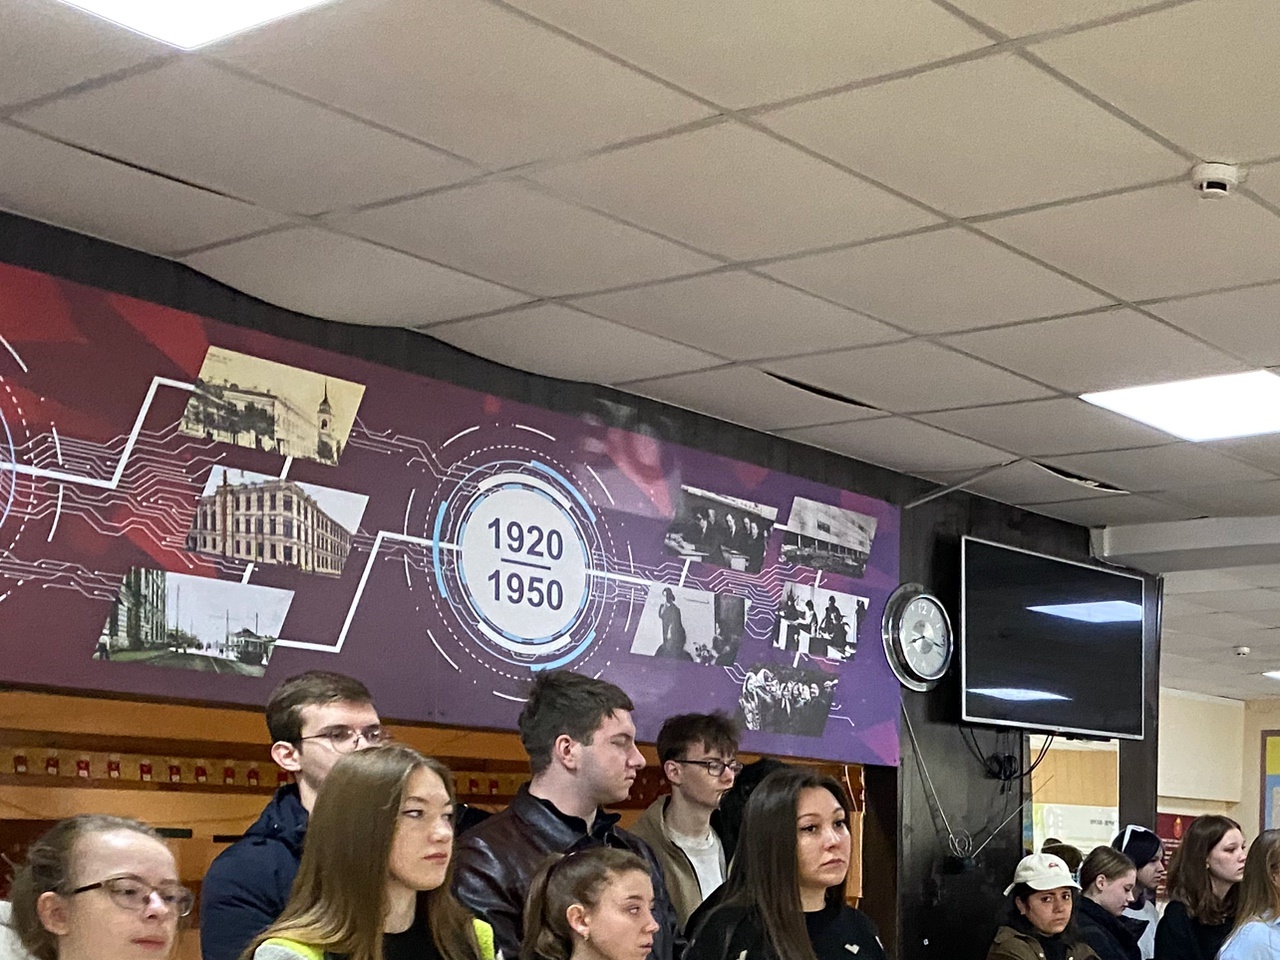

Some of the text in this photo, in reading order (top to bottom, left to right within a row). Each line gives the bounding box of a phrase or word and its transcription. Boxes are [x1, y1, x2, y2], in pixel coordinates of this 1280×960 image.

[487, 518, 564, 560] 1920
[487, 569, 564, 611] 1950
[918, 602, 928, 614] 12
